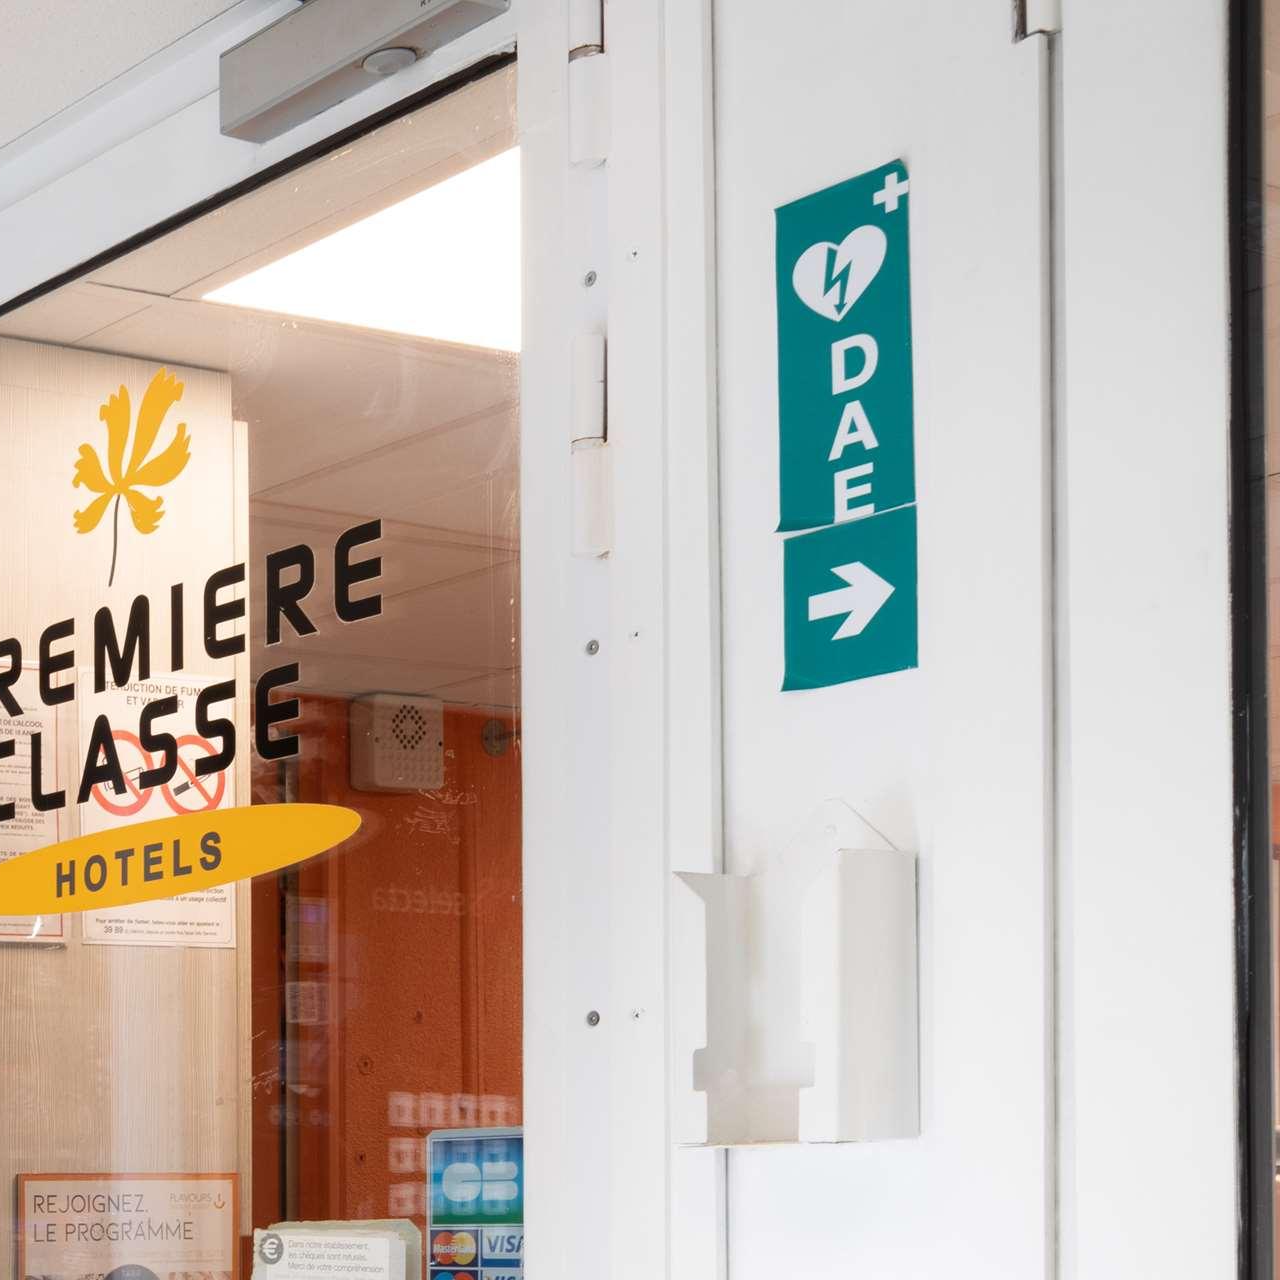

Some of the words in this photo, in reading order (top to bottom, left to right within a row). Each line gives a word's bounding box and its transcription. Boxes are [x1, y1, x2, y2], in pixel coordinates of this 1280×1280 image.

[828, 332, 880, 524] DAE
[126, 696, 138, 705] ET
[165, 686, 177, 695] DE
[54, 832, 223, 898] HOTELS
[34, 1223, 57, 1242] LE
[64, 1221, 194, 1242] PROGRAMME
